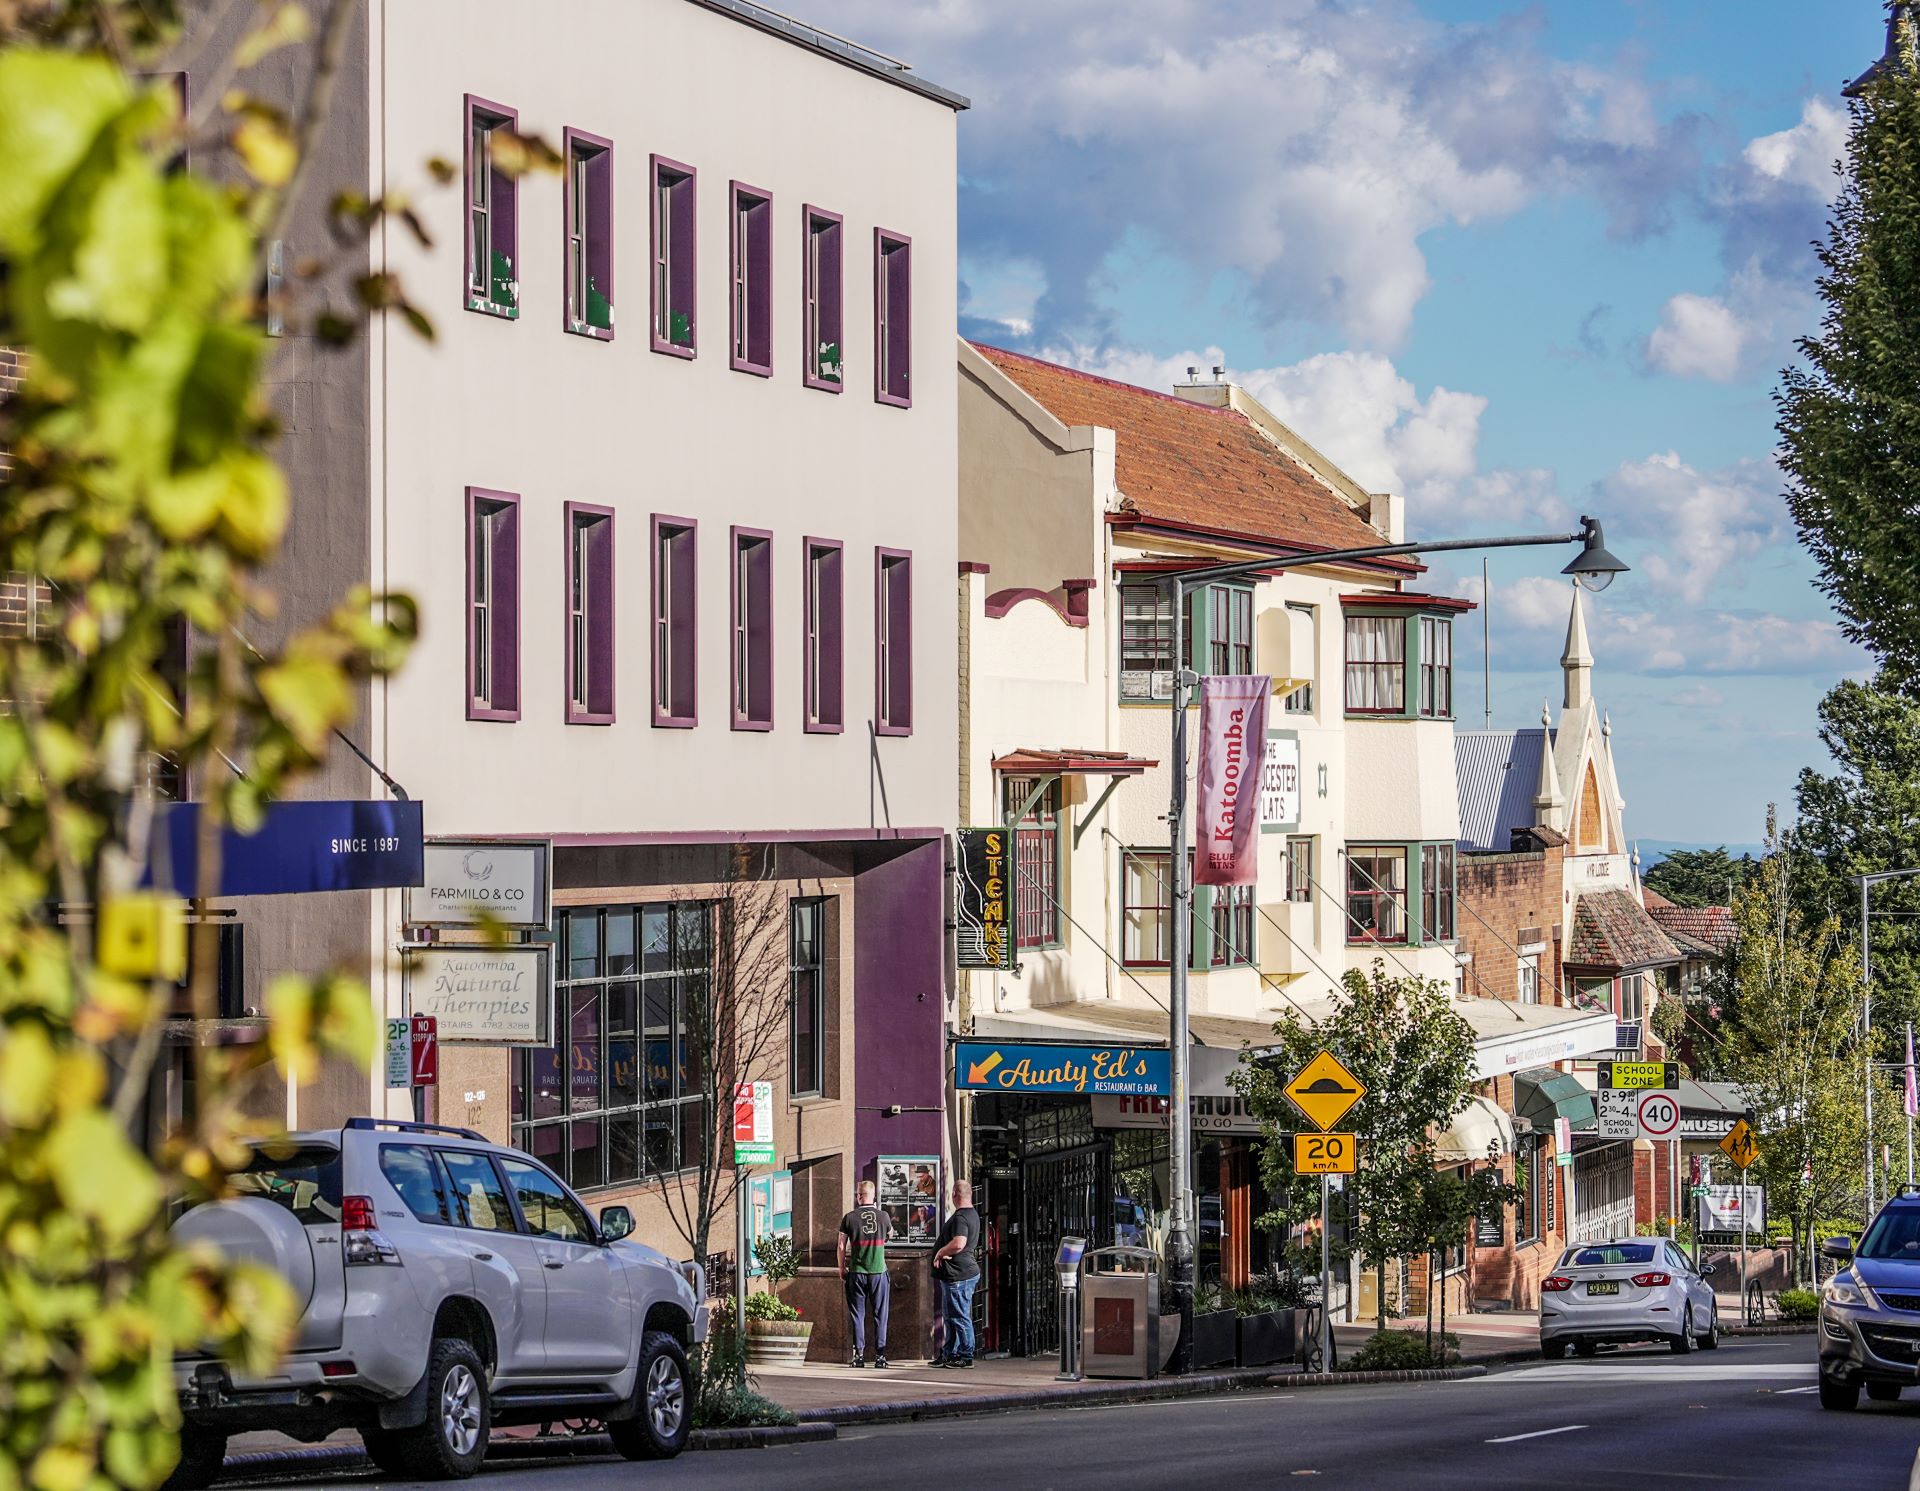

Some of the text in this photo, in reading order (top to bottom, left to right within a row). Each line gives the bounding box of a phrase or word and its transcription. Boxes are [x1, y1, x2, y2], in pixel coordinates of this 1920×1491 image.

[1215, 707, 1244, 842] Katoomba
[1262, 764, 1297, 792] CESTER
[1262, 797, 1285, 820] LATS
[331, 837, 399, 853] SINCE 1987
[1208, 852, 1235, 861] BLUE
[1208, 861, 1235, 869] MTNS
[431, 888, 524, 900] FARMILO & CO
[984, 833, 1004, 965] STEAKS
[441, 959, 516, 972] Katoomba
[435, 971, 525, 993] Natural
[427, 992, 530, 1021] Therapies
[387, 1022, 409, 1040] 2P
[418, 1020, 430, 1032] NO
[481, 1021, 503, 1030] 4782
[998, 1050, 1147, 1092] Aunty Ed's
[1616, 1066, 1661, 1075] SCHOOL
[1095, 1081, 1158, 1093] RESTAURANT & BAR
[1623, 1077, 1654, 1086] ZONE
[468, 1106, 481, 1126] 122
[1646, 1105, 1673, 1123] 40
[1194, 1117, 1232, 1128] TO GO
[1603, 1119, 1635, 1127] SCHOOL
[1680, 1120, 1736, 1132] MUSIC
[1308, 1138, 1343, 1159] 20
[1313, 1161, 1338, 1170] km/h
[861, 1211, 878, 1234] 3
